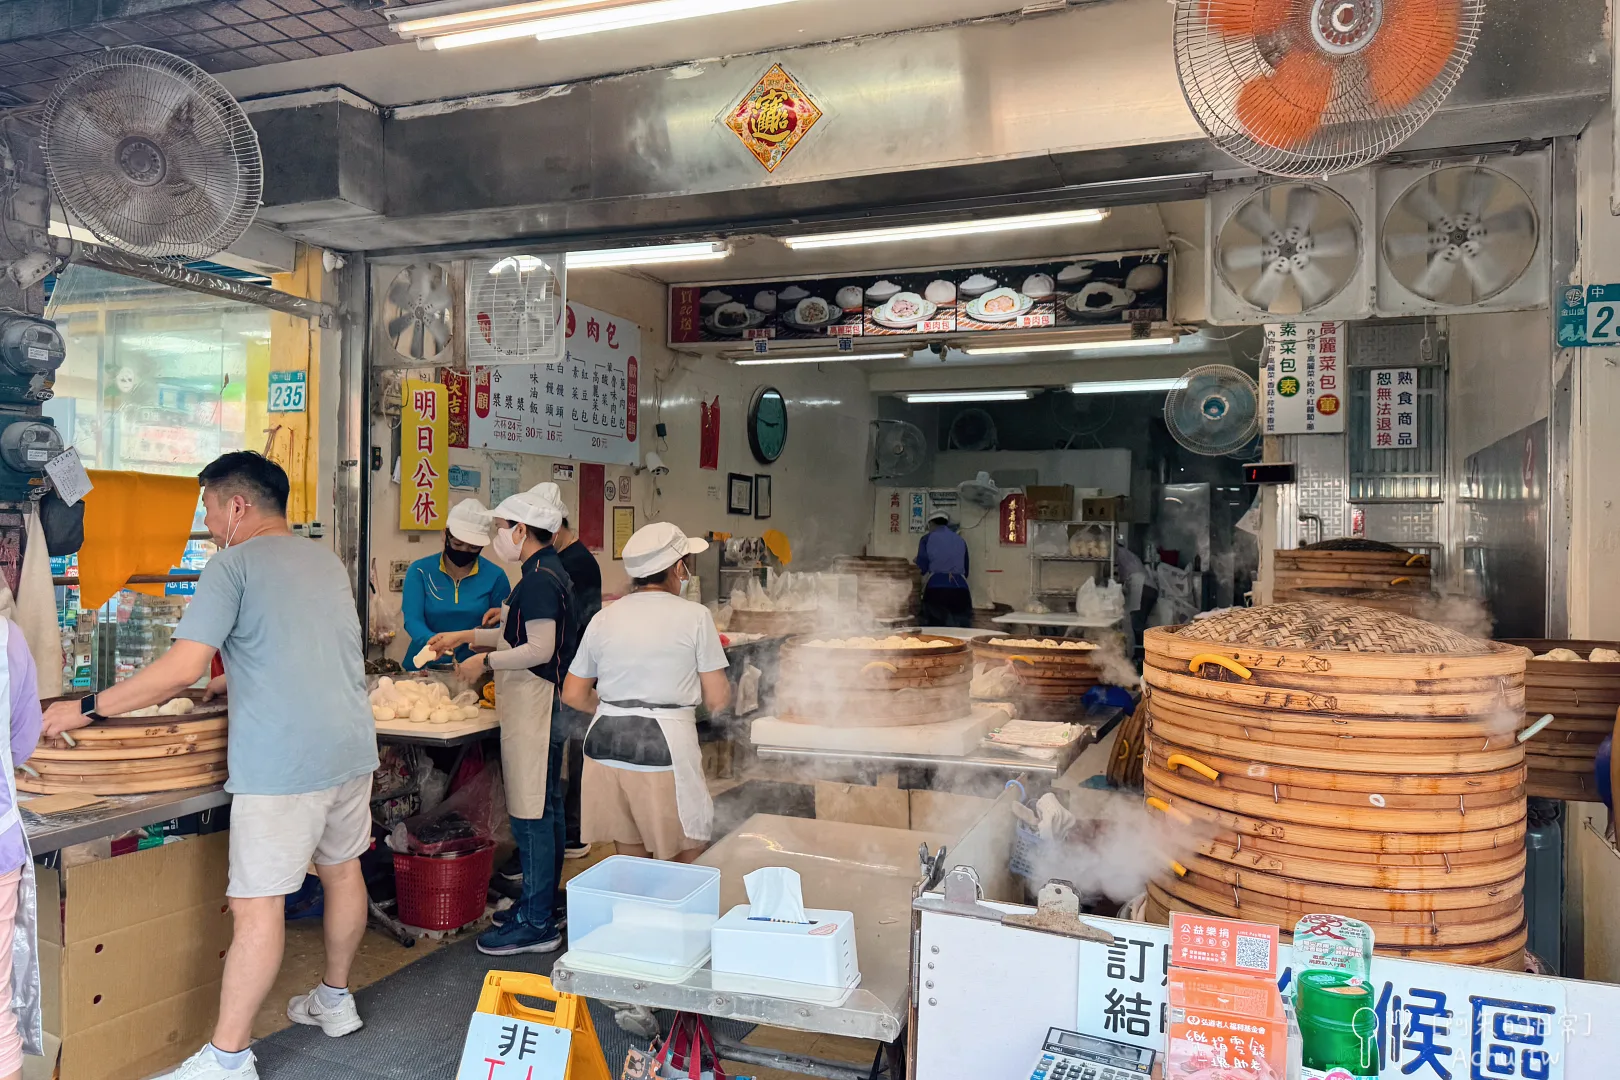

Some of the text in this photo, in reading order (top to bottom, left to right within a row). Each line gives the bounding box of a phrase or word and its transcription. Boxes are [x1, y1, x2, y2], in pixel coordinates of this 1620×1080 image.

[1592, 306, 1620, 338] 2
[1280, 323, 1297, 373] 素菜包
[1319, 322, 1337, 390] 高麗菜包
[273, 386, 303, 407] 235
[530, 364, 538, 414] 味油飯
[1280, 379, 1297, 394] 素
[494, 419, 523, 432] 大杯24元
[1377, 372, 1392, 446] 恕無法退換
[1398, 371, 1413, 446] 熟食商品
[494, 430, 523, 443] 中杯20元
[525, 427, 542, 440] 30元
[547, 430, 563, 443] 16元
[592, 437, 608, 448] 20元
[412, 390, 439, 526] 明日公休
[1181, 923, 1229, 939] 公益樂捐
[1107, 936, 1168, 986] 訂
[1104, 988, 1166, 1037] 結
[498, 1024, 538, 1060] 非
